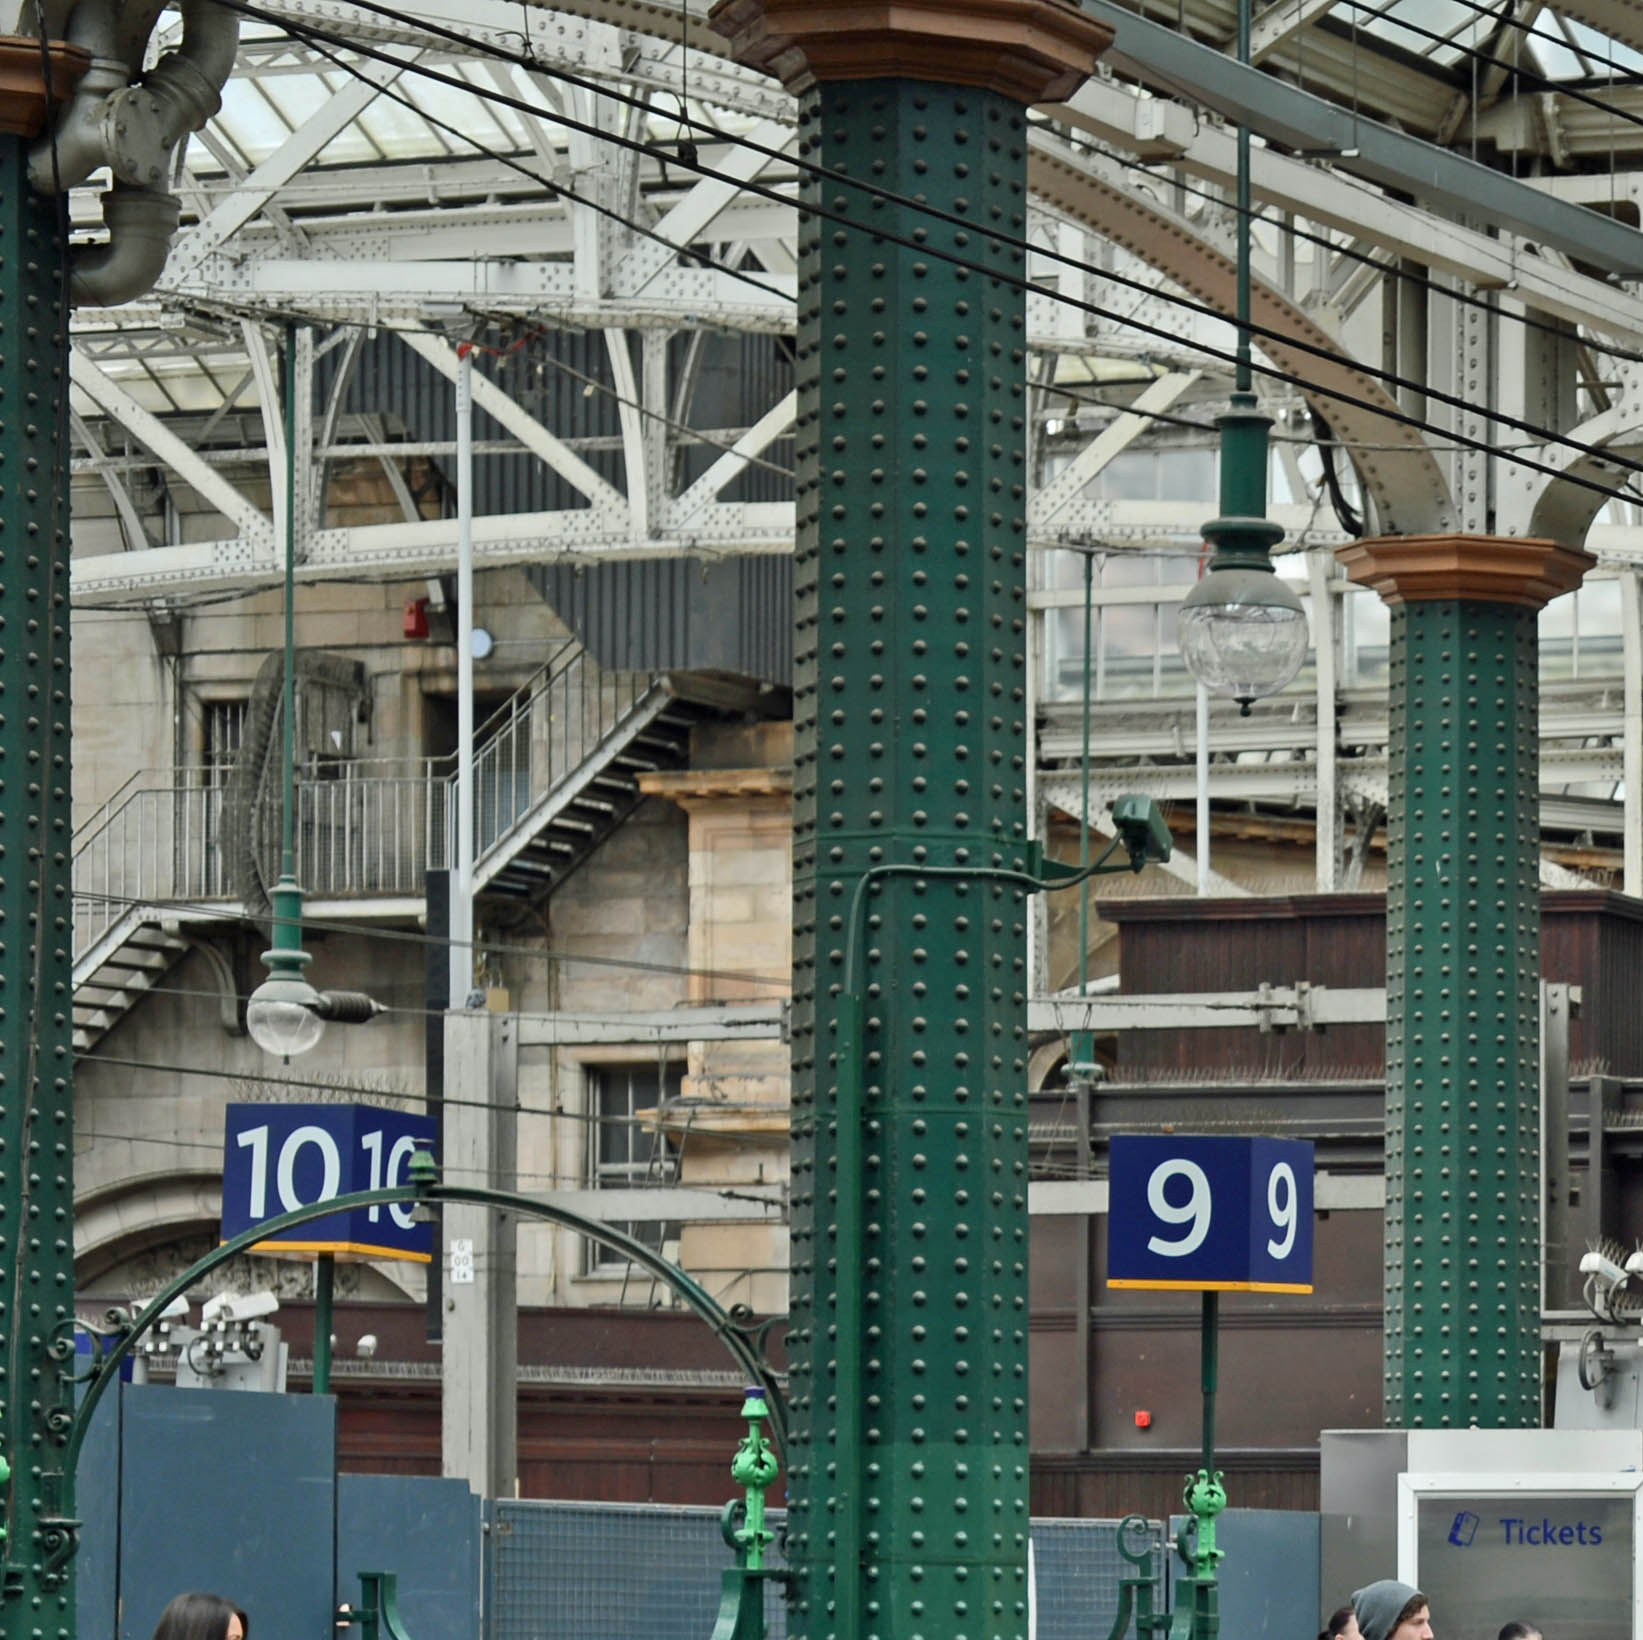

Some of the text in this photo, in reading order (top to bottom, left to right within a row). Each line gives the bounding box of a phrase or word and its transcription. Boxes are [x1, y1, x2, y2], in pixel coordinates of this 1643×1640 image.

[236, 1124, 341, 1219] 10
[1145, 1157, 1299, 1262] 9 9
[1499, 1517, 1604, 1547] Tickets
